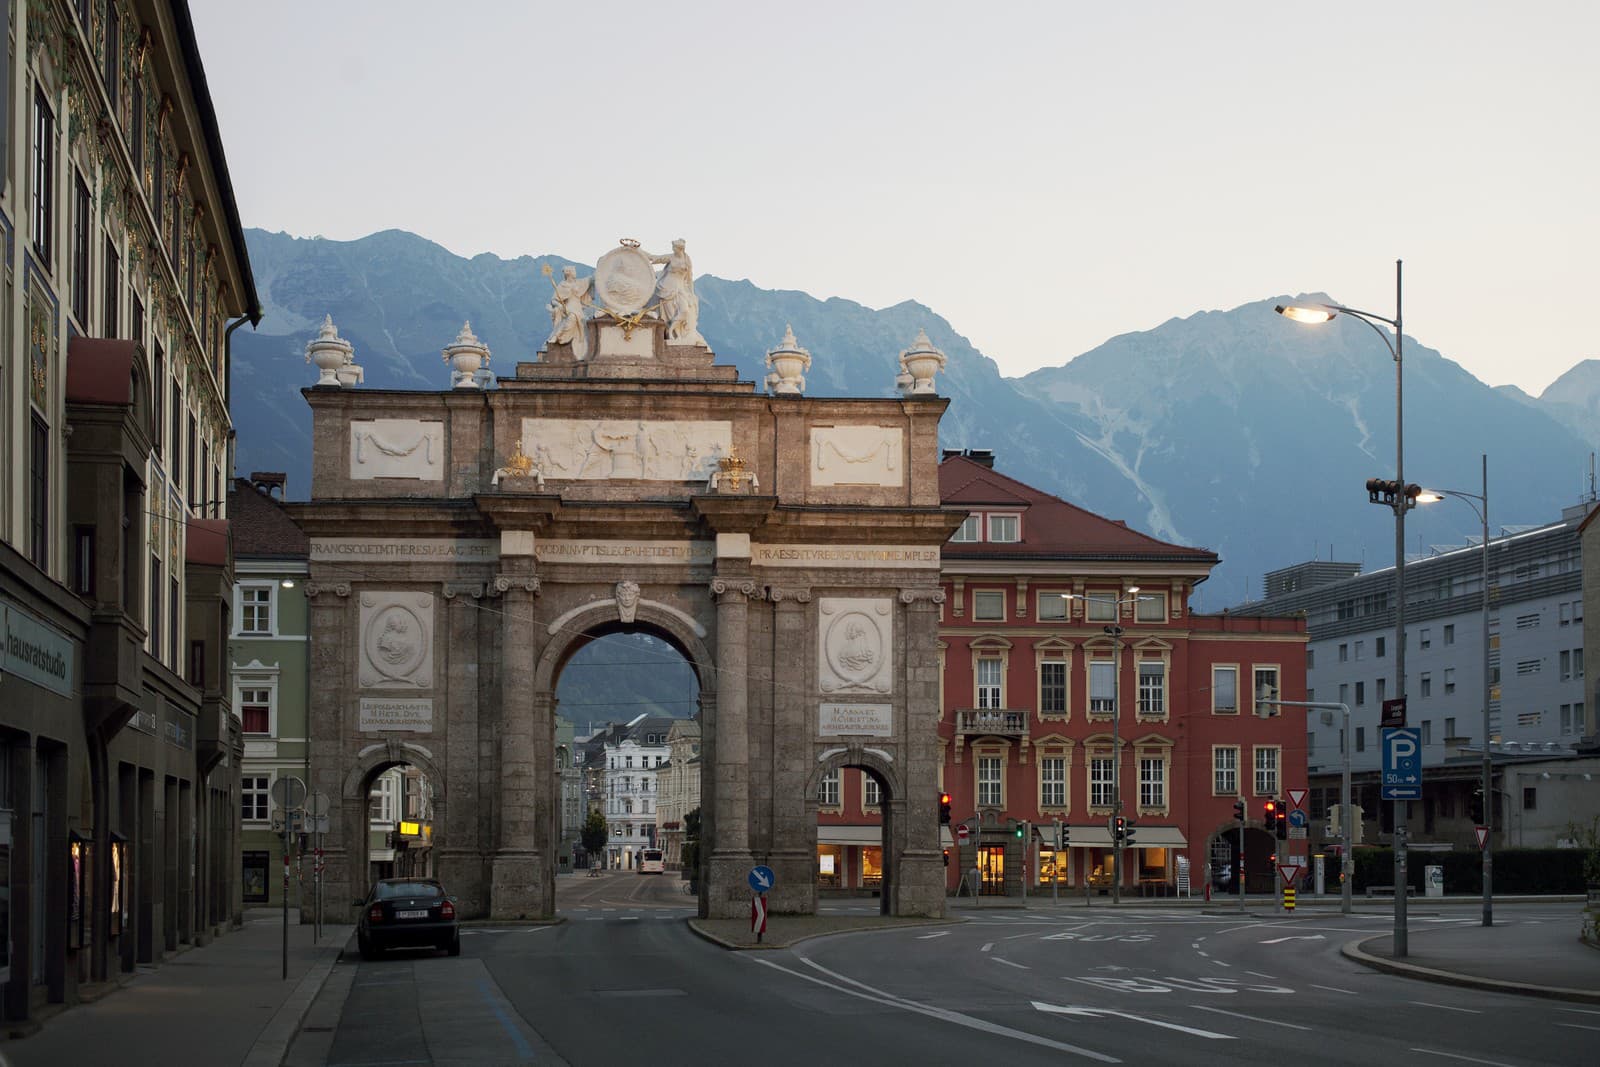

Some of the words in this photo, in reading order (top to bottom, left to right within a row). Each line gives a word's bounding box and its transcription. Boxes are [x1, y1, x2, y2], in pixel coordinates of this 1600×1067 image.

[6, 624, 66, 680] hausratstudio
[1391, 739, 1416, 770] P
[1041, 932, 1157, 942] BUS
[1061, 976, 1296, 994] BUS
